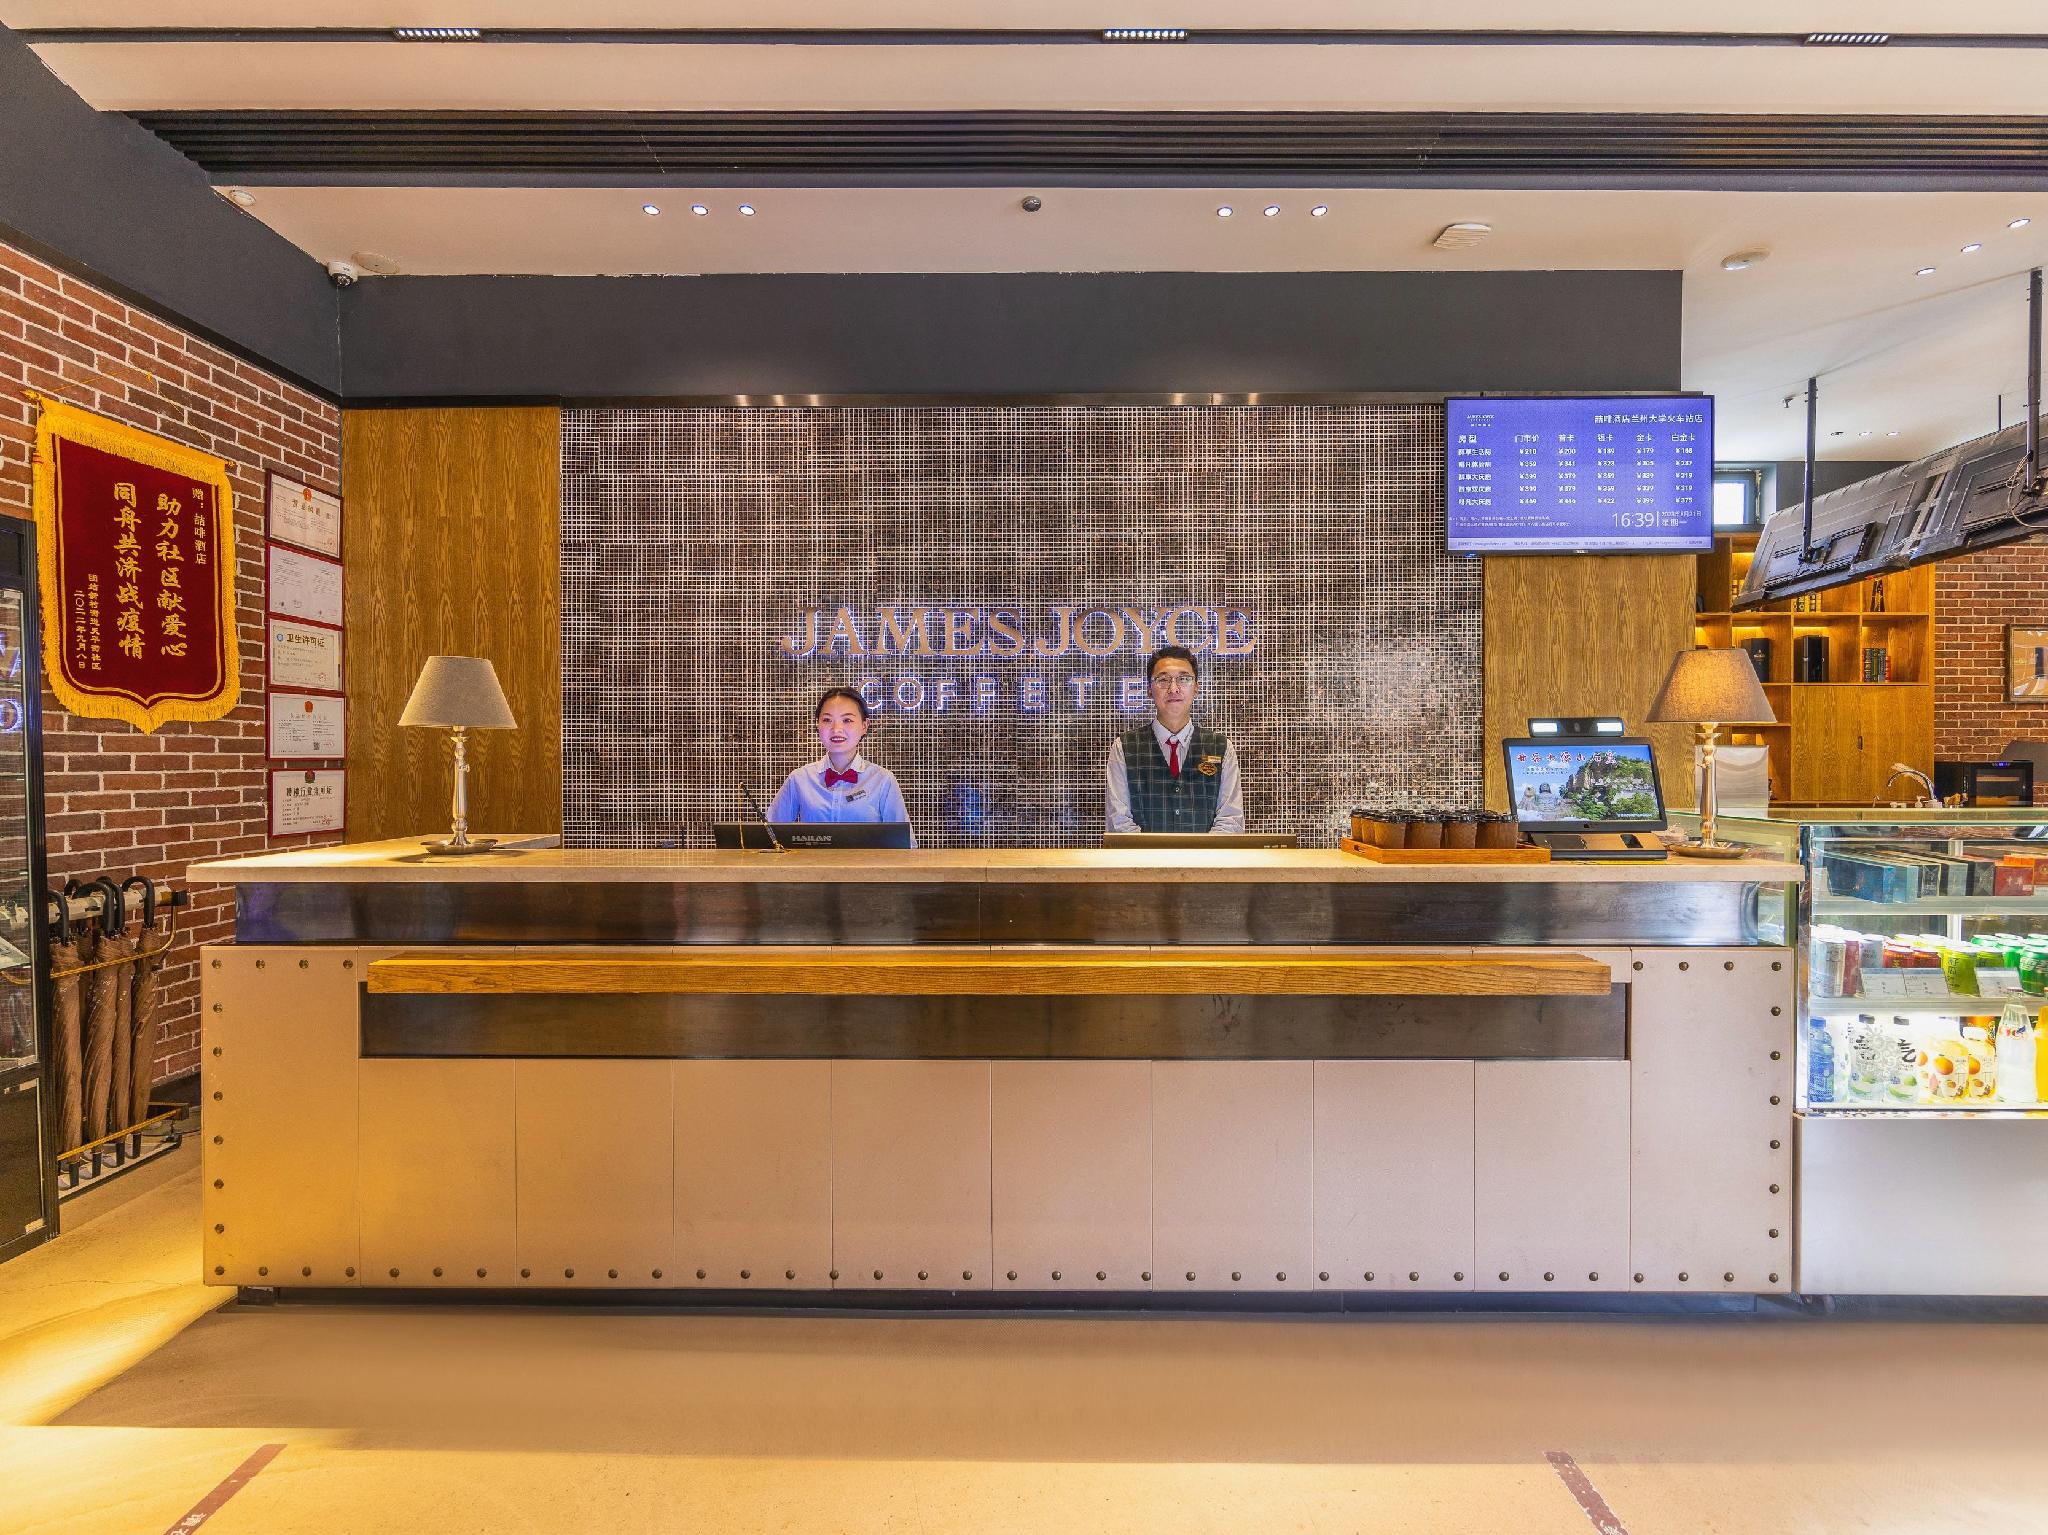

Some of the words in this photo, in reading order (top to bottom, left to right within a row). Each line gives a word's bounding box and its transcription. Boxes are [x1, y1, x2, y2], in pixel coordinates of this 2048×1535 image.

[1636, 433, 1653, 442] 金卡
[1671, 433, 1696, 442] 白金卡
[1612, 512, 1655, 528] 16:39
[1661, 518, 1688, 527] 星期一
[113, 482, 146, 660] 同舟共济战疫情
[155, 493, 189, 657] 助力社区献爱心
[287, 633, 326, 648] 卫生许可证
[780, 606, 1025, 657] JAMES
[1035, 606, 1259, 657] JOYCE
[855, 677, 1147, 710] COFFETE
